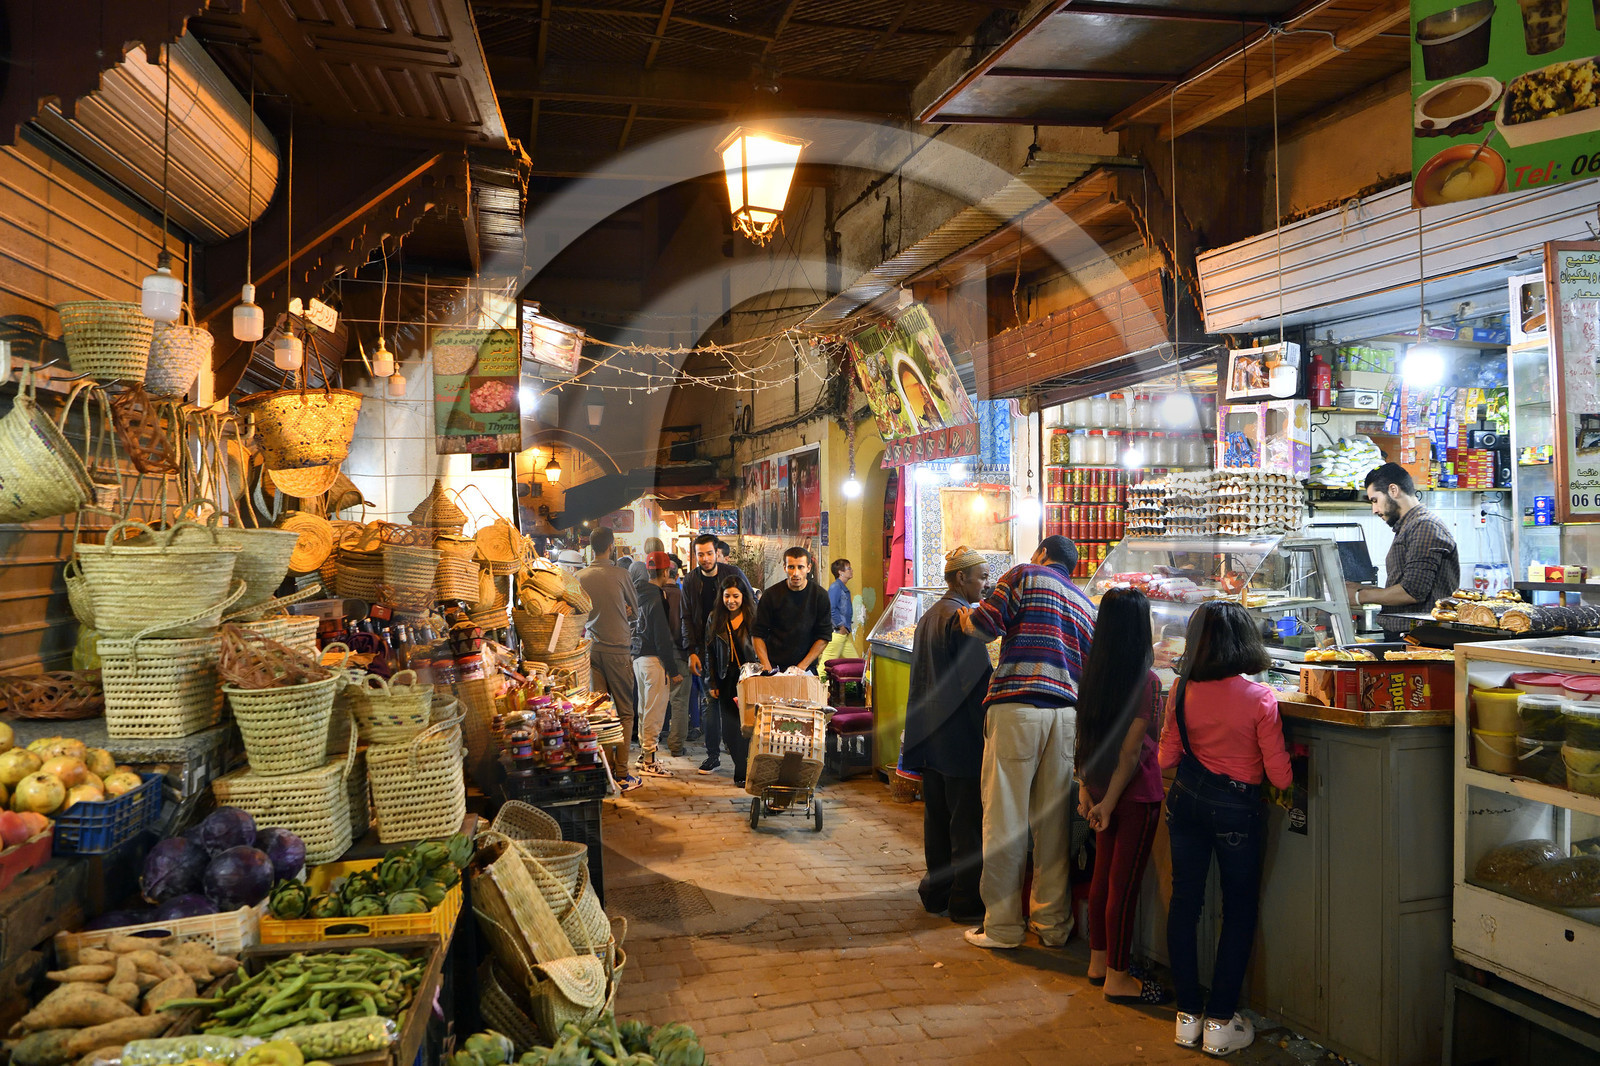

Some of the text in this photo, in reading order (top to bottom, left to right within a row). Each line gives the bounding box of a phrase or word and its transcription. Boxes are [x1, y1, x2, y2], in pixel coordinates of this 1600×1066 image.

[1514, 160, 1562, 188] Tel:
[1565, 253, 1600, 268] لخليع
[483, 364, 517, 372] d'oranger
[1572, 493, 1589, 507] 06
[1390, 673, 1406, 711] Pipas
